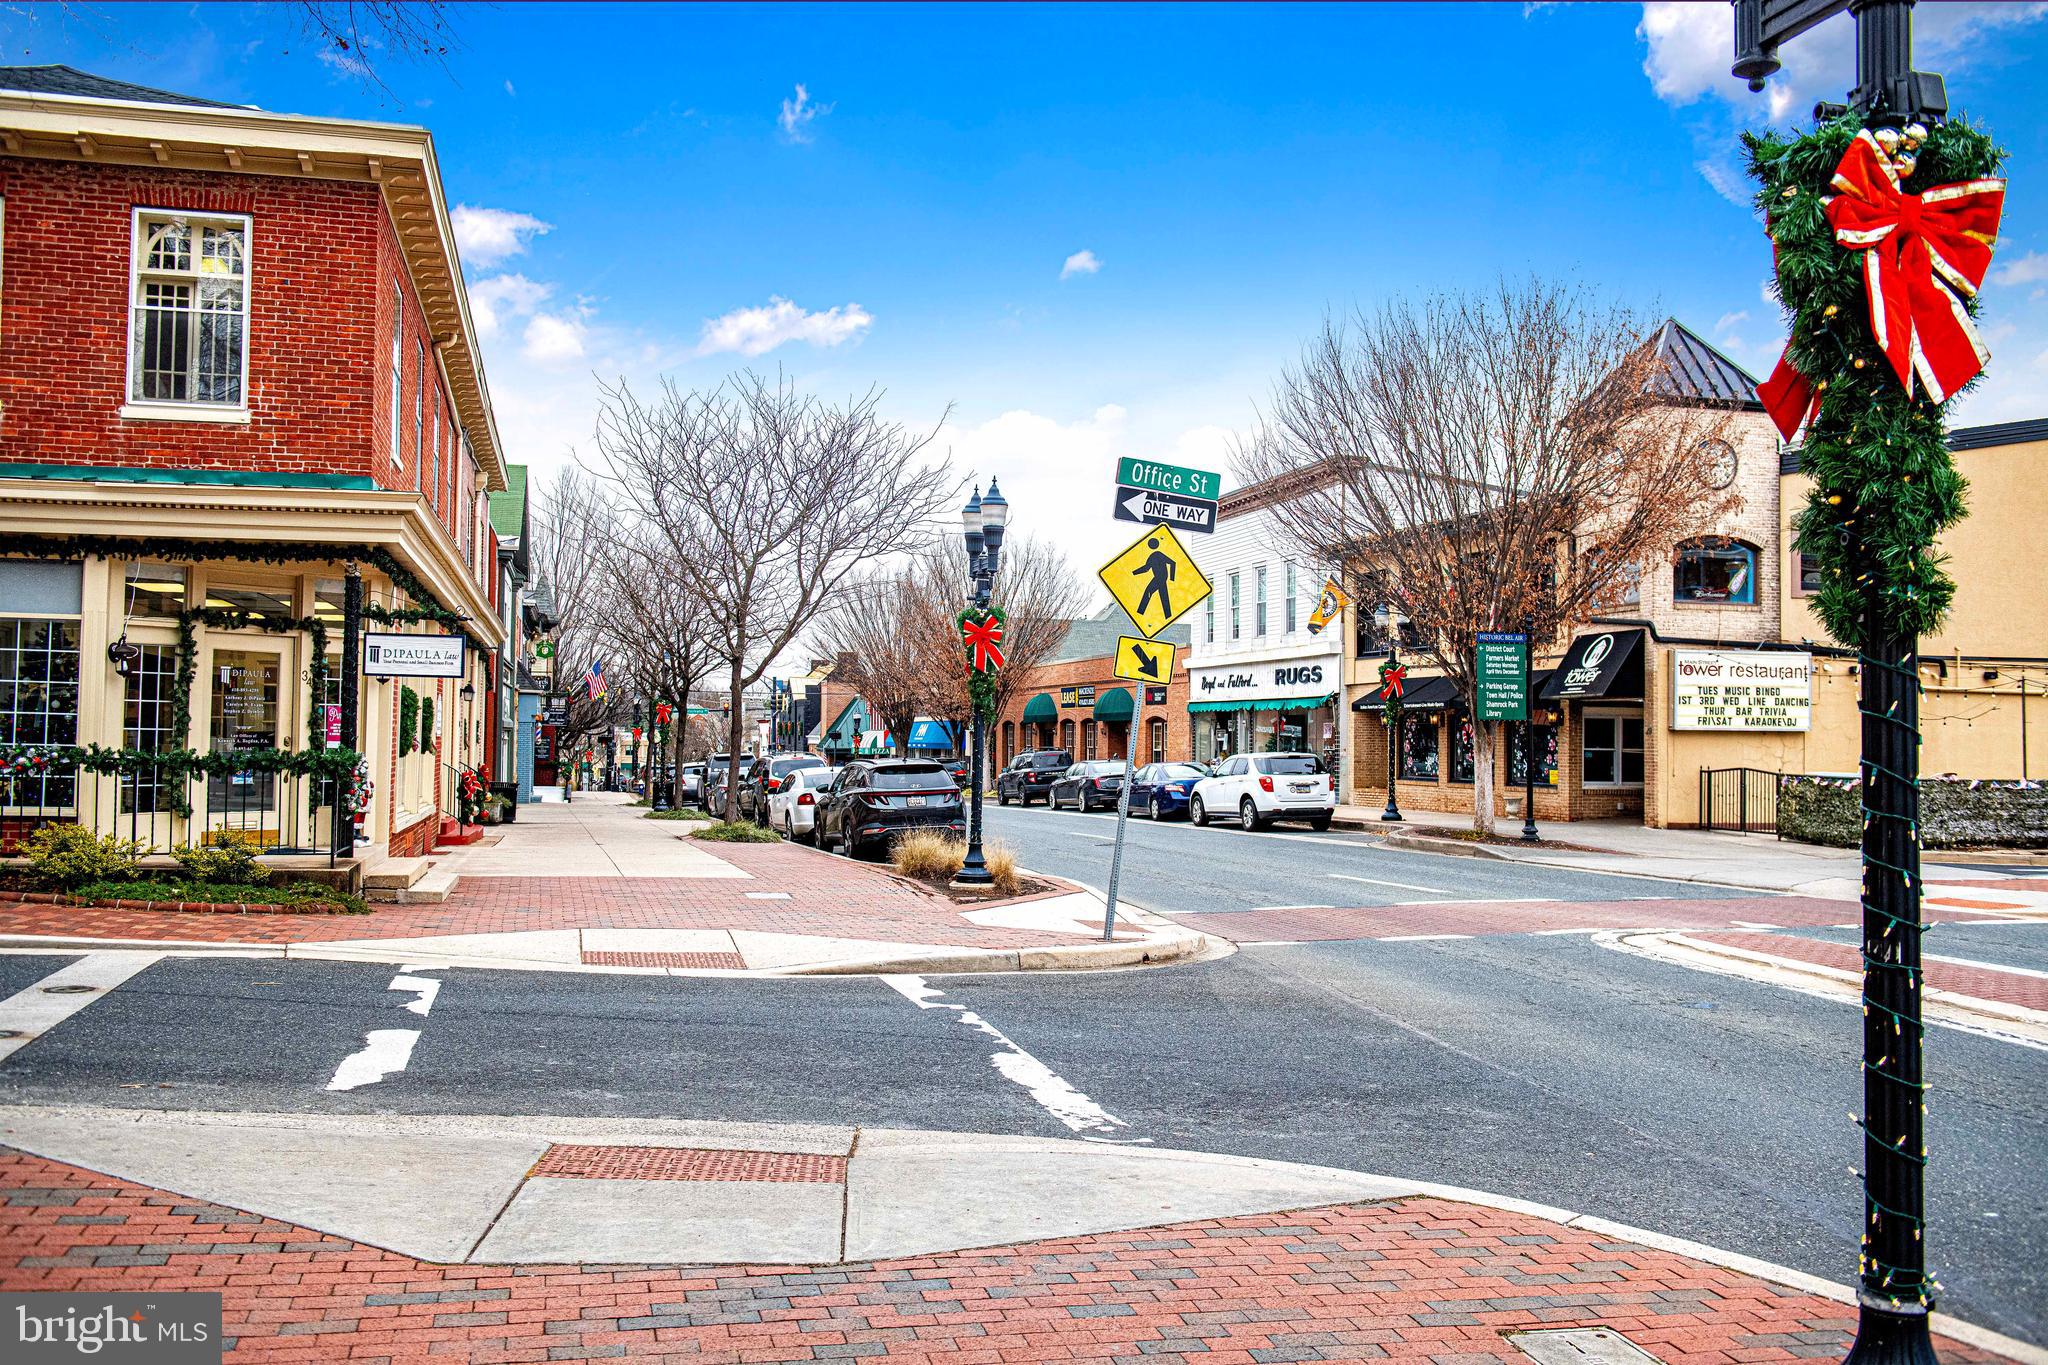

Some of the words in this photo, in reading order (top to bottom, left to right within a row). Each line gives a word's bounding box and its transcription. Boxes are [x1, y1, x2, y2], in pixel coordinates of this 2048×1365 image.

[1132, 463, 1182, 490] Office
[1189, 474, 1208, 494] St
[1144, 501, 1170, 517] ONE
[1177, 506, 1205, 522] WAY
[383, 649, 441, 659] DIPAULA
[444, 651, 460, 660] law
[232, 669, 271, 678] DIPAULA
[1275, 665, 1322, 686] RUGS
[1679, 661, 1723, 676] tower
[1730, 664, 1809, 679] restaurant
[1564, 670, 1602, 684] tower
[1201, 676, 1216, 694] Boyd
[1698, 687, 1718, 695] TUES
[1725, 687, 1751, 696] MUSIC
[1756, 688, 1780, 696] BINGO
[1061, 692, 1075, 704] LEASE
[1700, 697, 1714, 705] 3RD
[1723, 697, 1739, 706] WED
[1748, 698, 1766, 706] LINE
[1775, 698, 1809, 707] DANCING
[1486, 710, 1502, 718] Library
[1704, 707, 1725, 716] THUR
[1736, 707, 1752, 716] BAR
[1760, 708, 1787, 716] TRIVIA
